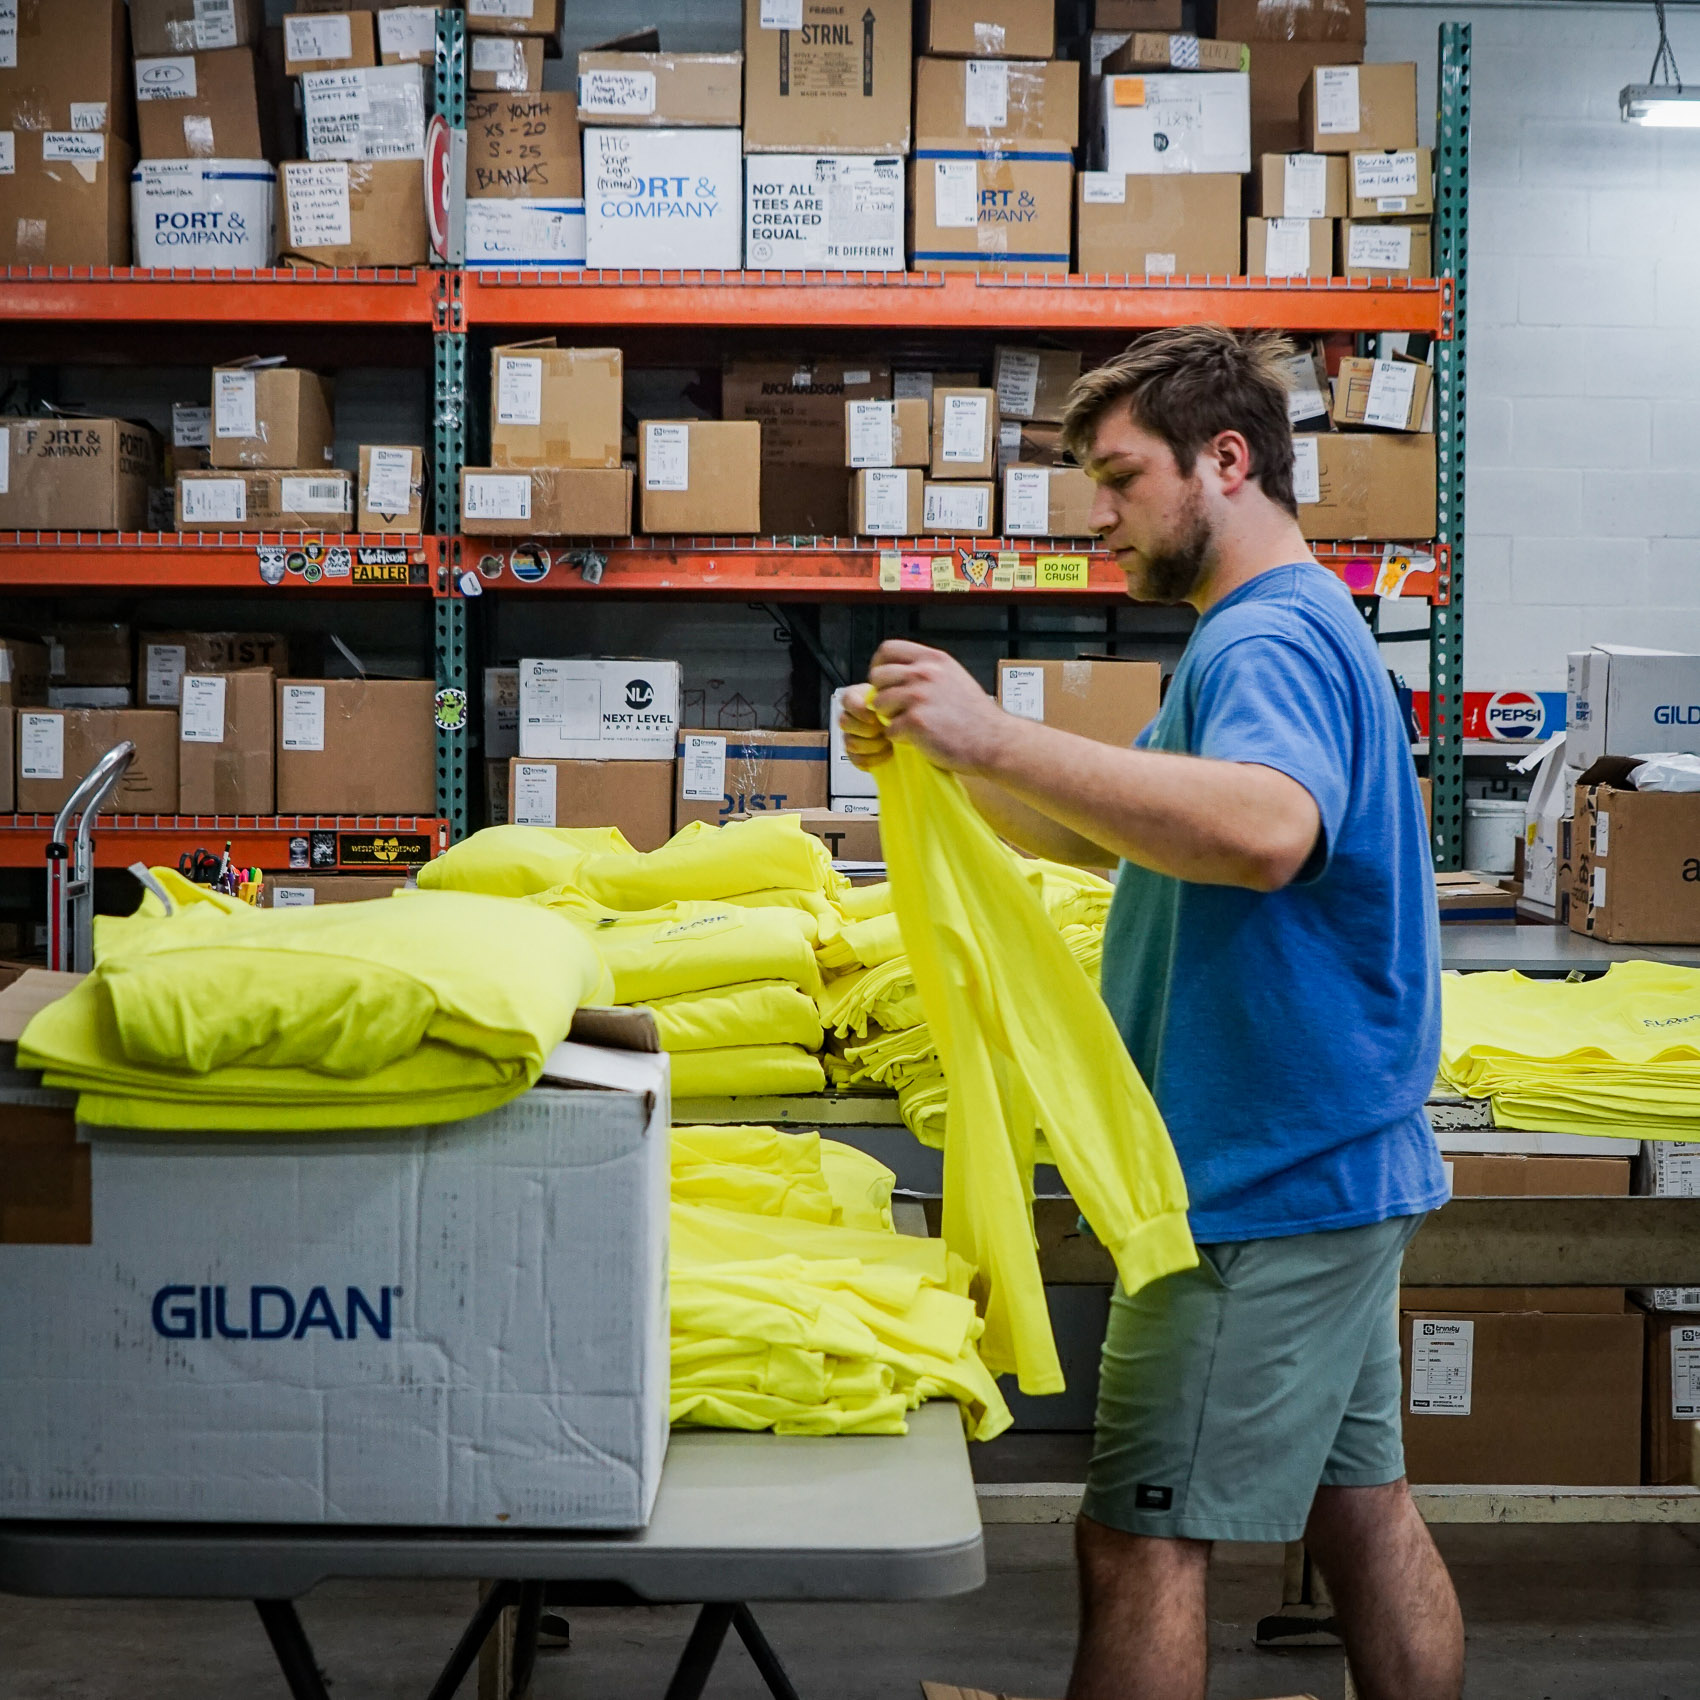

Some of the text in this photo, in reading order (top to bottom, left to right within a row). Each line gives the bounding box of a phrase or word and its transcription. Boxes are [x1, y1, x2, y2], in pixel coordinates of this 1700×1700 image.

[809, 6, 844, 15] FRAGILE
[801, 24, 854, 45] STRNL
[507, 103, 550, 122] YOUTH
[311, 124, 360, 134] CREATED
[484, 124, 504, 138] XS
[523, 121, 546, 136] 20
[519, 144, 541, 158] 25
[476, 161, 549, 190] BLANKS
[695, 177, 716, 198] &
[752, 184, 816, 195] NOT ALL
[752, 199, 824, 210] TEES ARE
[1018, 190, 1035, 207] &
[601, 201, 719, 218] COMPANY
[155, 212, 246, 229] PORT &
[752, 213, 822, 225] CREATED
[155, 231, 247, 245] COMPANY
[752, 228, 807, 240] EQUAL.
[843, 246, 894, 256] DIFFERENT
[761, 382, 845, 395] RICHARDSON
[86, 430, 101, 444] &
[352, 566, 407, 580] FALTER
[1044, 563, 1081, 572] DO NOT
[1045, 573, 1080, 581] CRUSH
[625, 688, 655, 702] NLA
[603, 714, 673, 723] NEXT LEVEL
[1490, 709, 1541, 721] PEPSI
[151, 1285, 392, 1340] GILDAN
[1435, 1325, 1460, 1334] trinity
